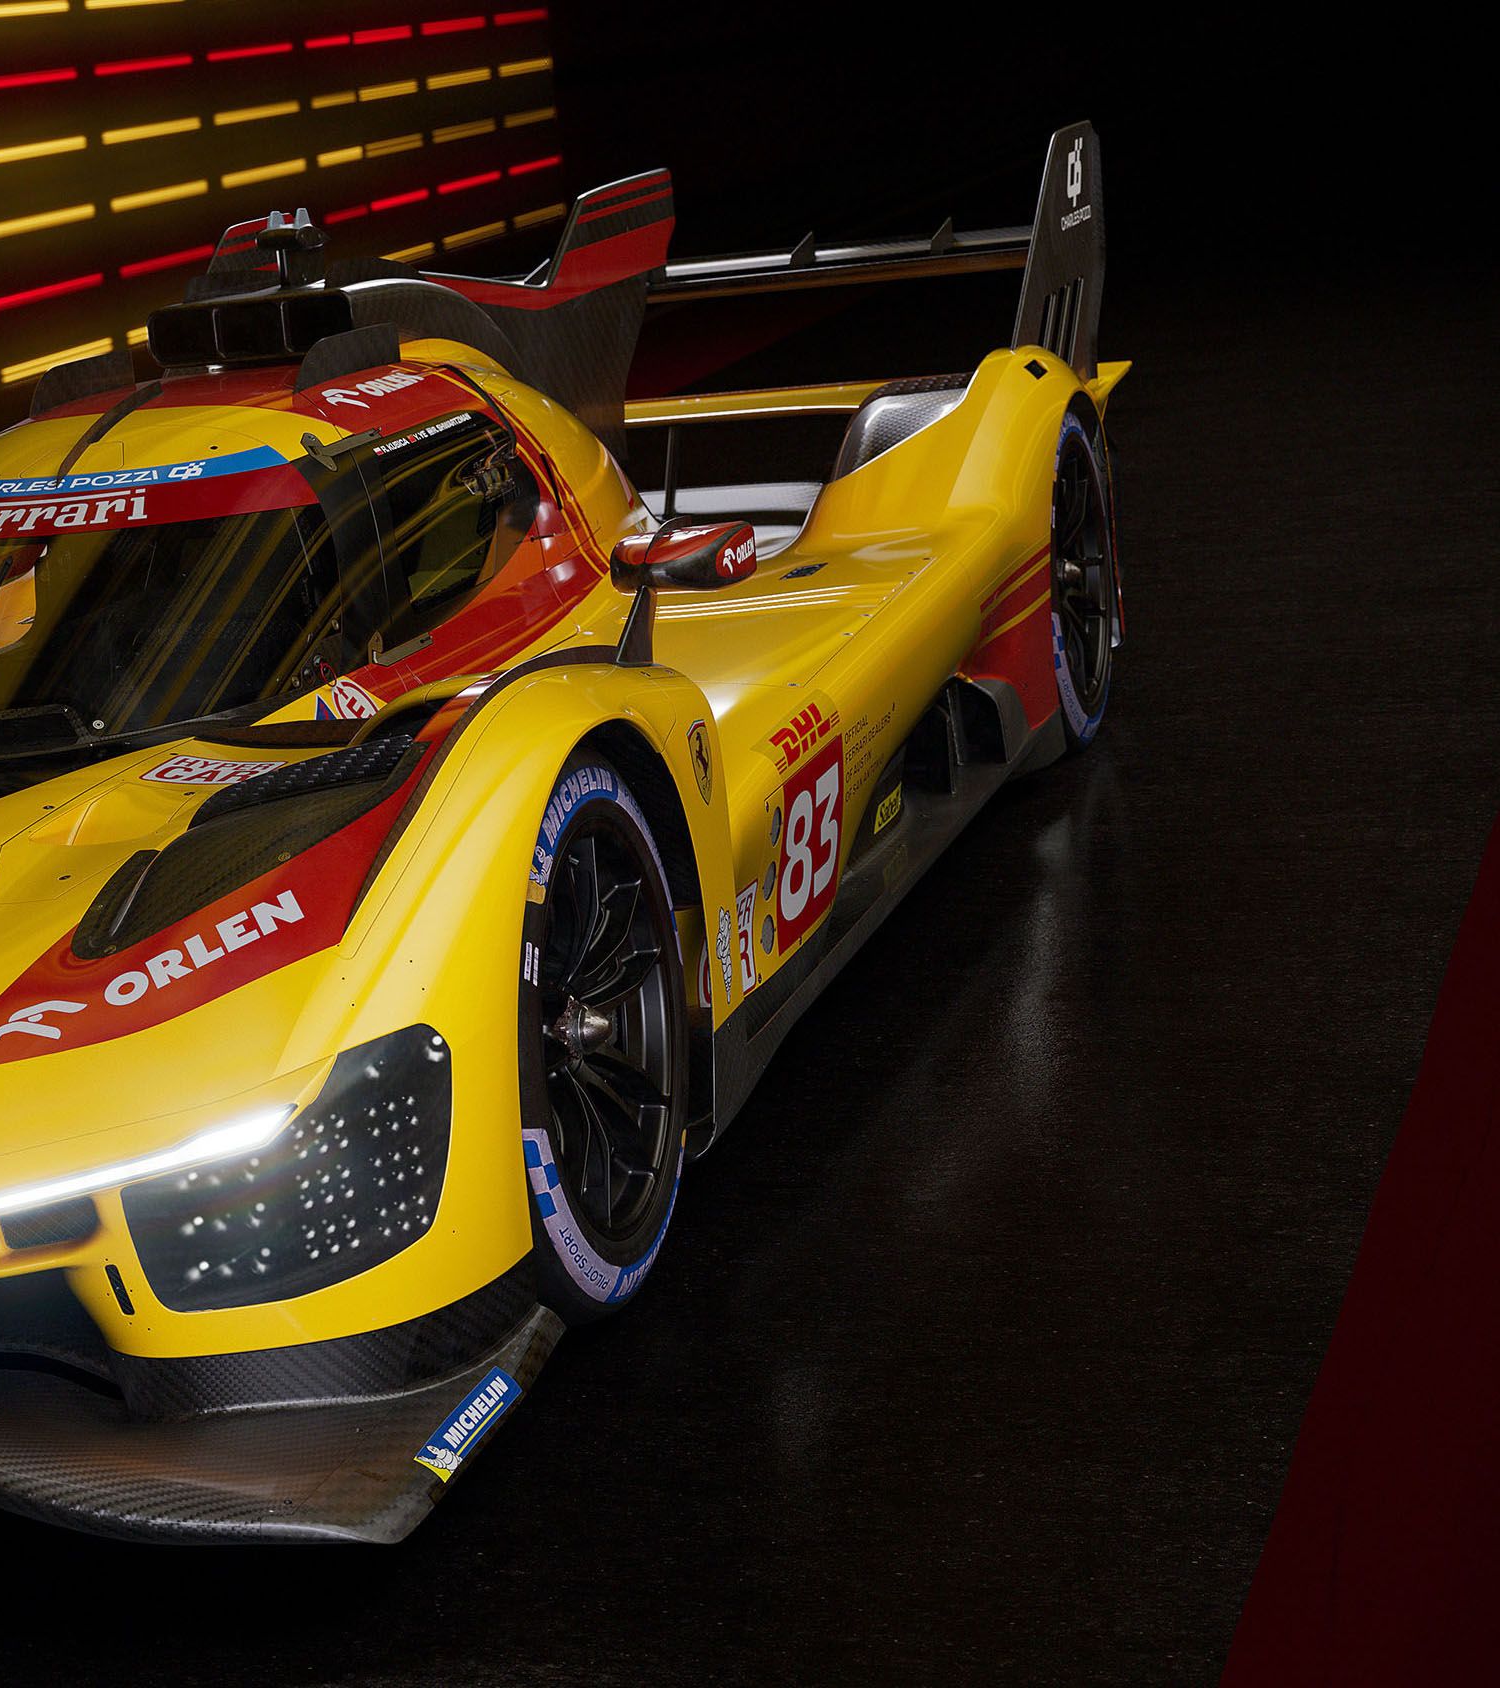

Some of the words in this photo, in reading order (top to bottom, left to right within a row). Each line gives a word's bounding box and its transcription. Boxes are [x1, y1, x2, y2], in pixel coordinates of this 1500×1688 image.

[355, 369, 425, 397] ORLEN
[70, 470, 159, 489] POZZI
[736, 536, 755, 564] ORLEN
[769, 702, 831, 767] DHL
[154, 766, 254, 783] CAR
[173, 757, 273, 770] HYPER
[541, 767, 613, 844] MICHELIN
[781, 762, 839, 921] 83
[104, 889, 305, 1007] ORLEN
[559, 1227, 588, 1269] SPORT
[583, 1266, 610, 1290] PILOT
[442, 1375, 509, 1449] MICHELIN
